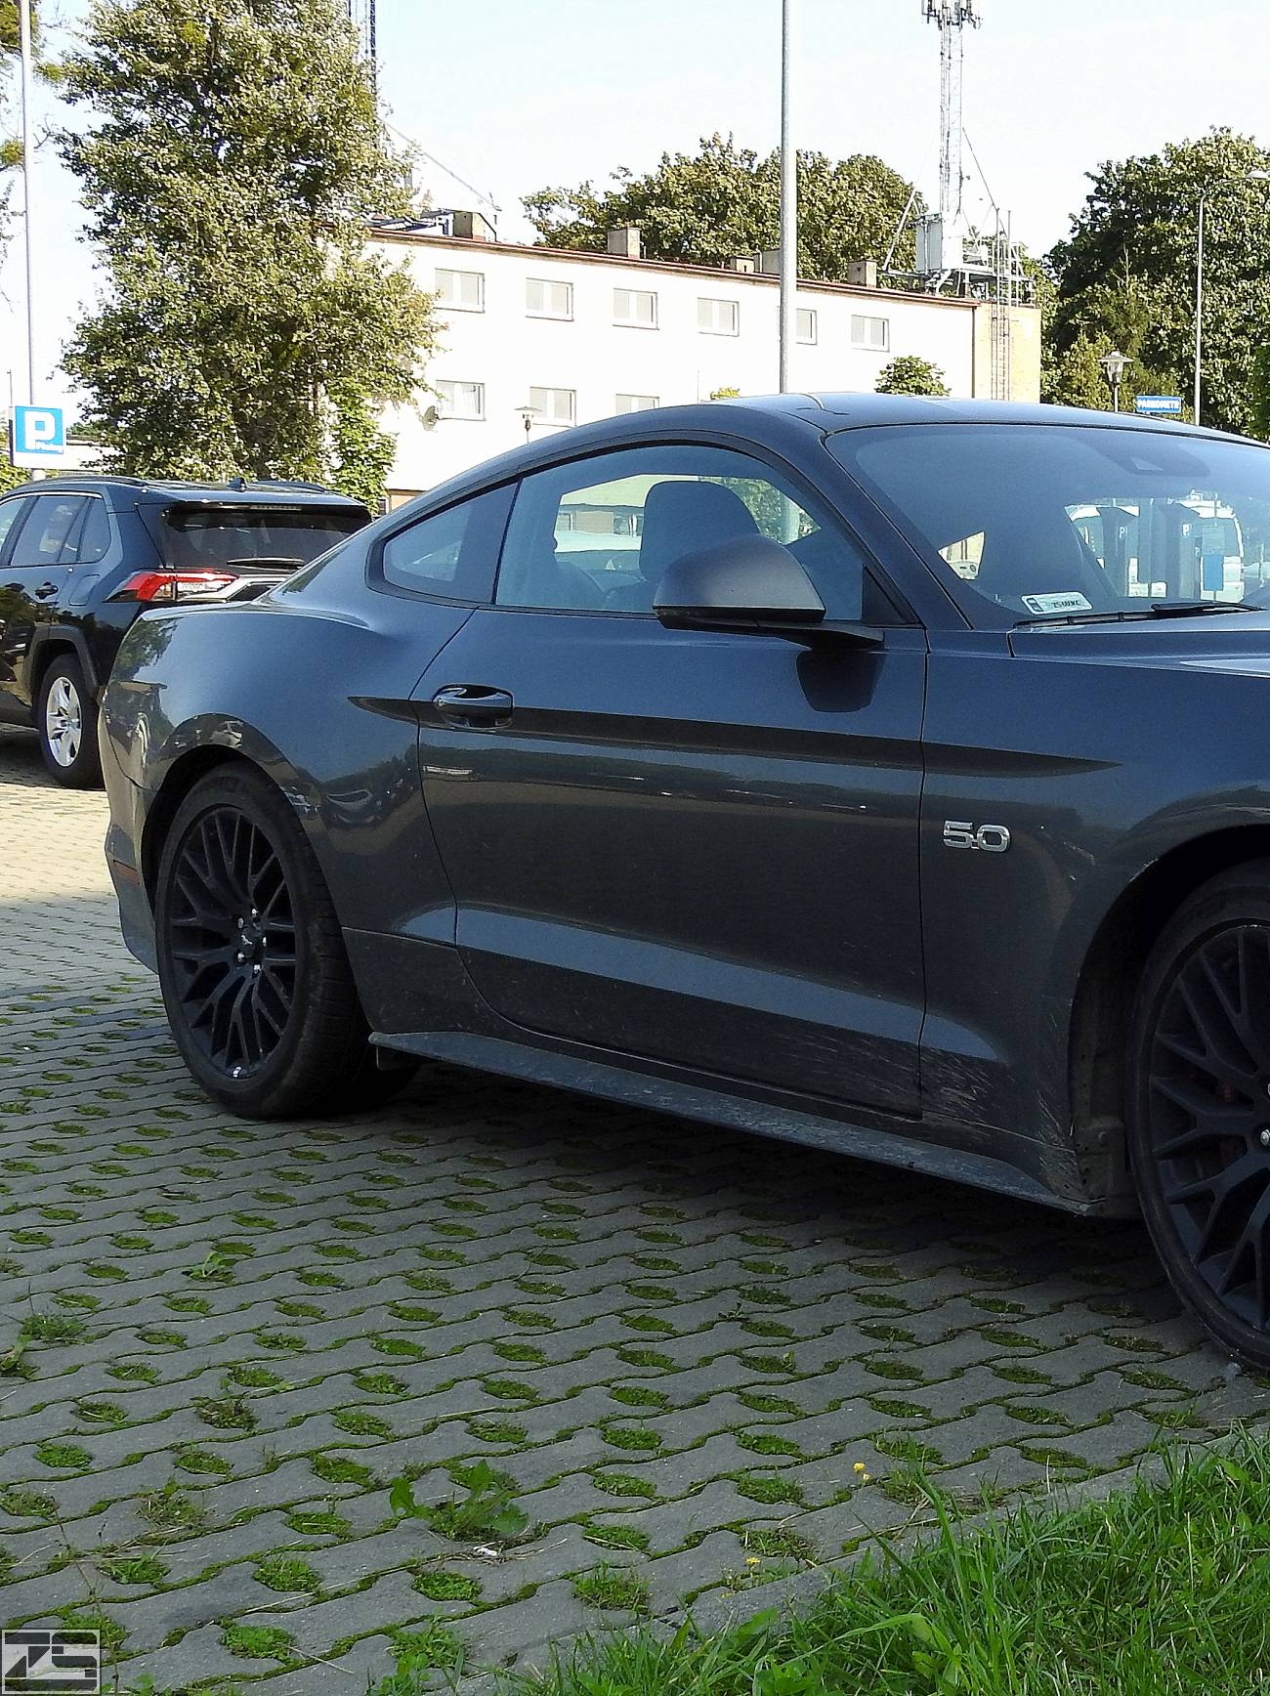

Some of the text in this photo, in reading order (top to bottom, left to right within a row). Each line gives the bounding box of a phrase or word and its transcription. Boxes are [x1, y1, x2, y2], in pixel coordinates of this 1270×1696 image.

[24, 410, 56, 450] P
[1182, 523, 1190, 537] P
[943, 820, 1011, 853] 5.0
